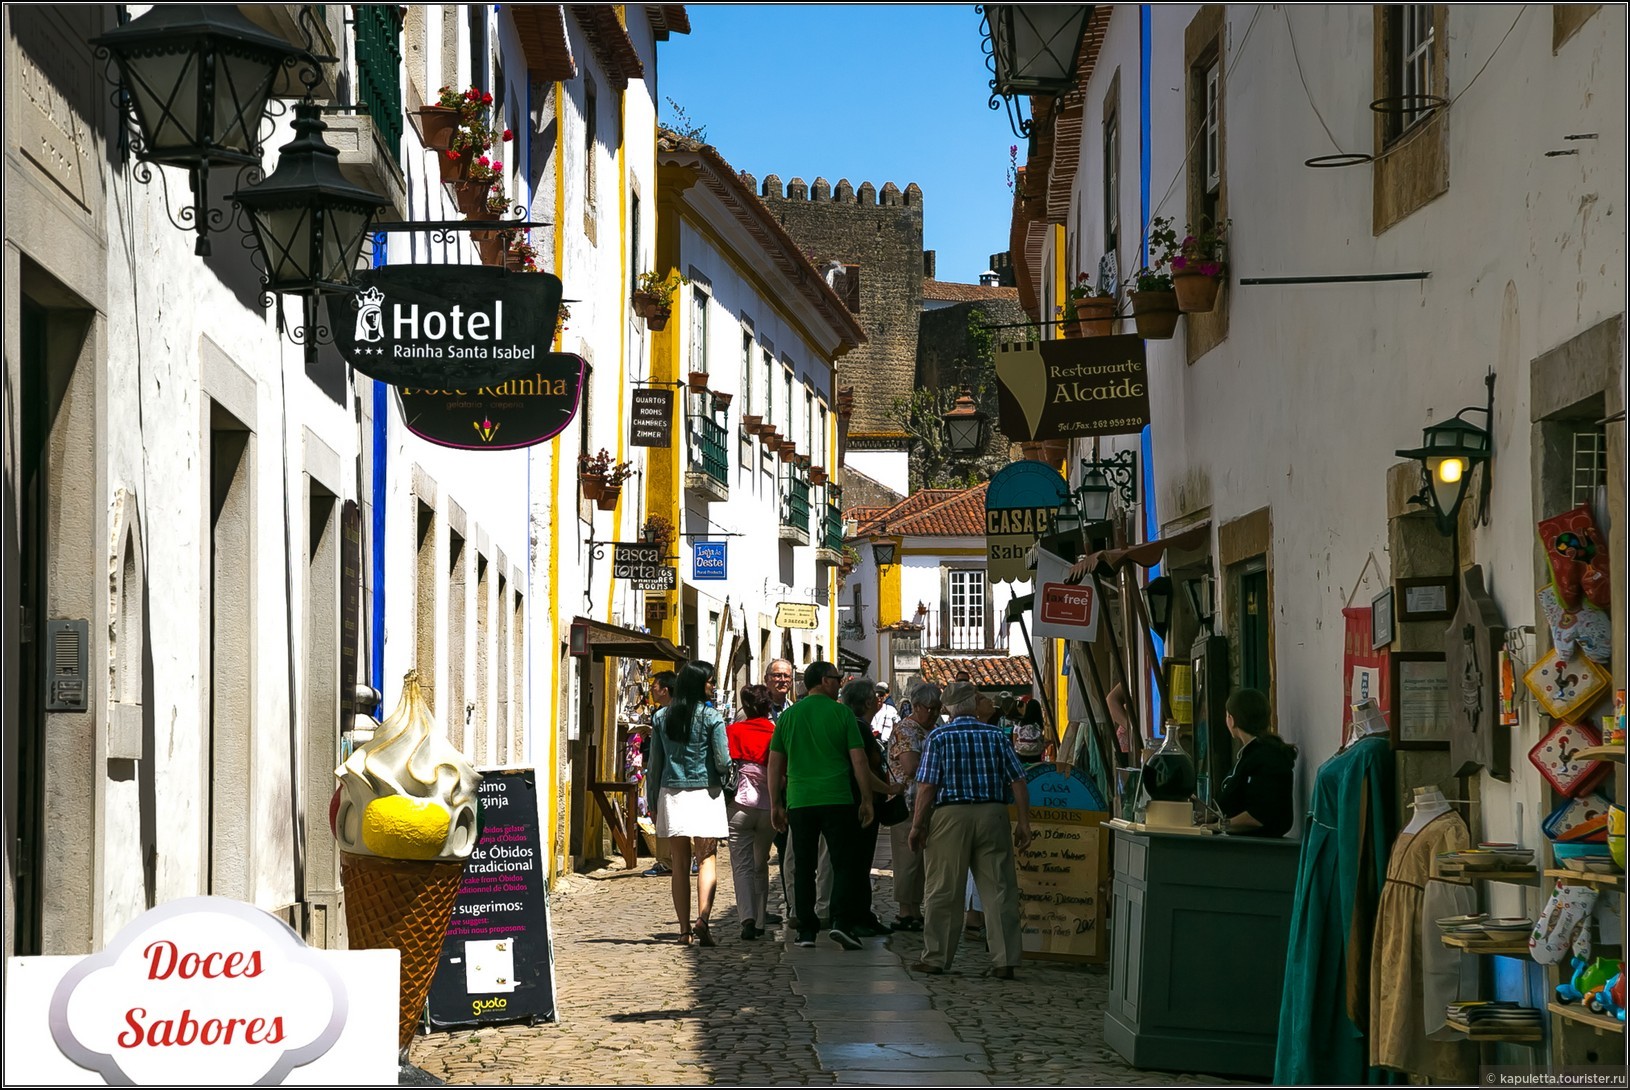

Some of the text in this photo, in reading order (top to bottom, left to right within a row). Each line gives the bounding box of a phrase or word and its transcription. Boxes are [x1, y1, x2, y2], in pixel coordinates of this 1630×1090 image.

[393, 300, 502, 340] Hotel
[394, 344, 535, 360] Rainha Santa Isabel
[1050, 360, 1141, 378] Restaurante
[1052, 378, 1143, 404] Alcaide
[446, 401, 482, 410] gelataria
[635, 397, 666, 405] QUARTOS
[640, 408, 662, 416] ROOMS
[633, 418, 667, 427] CHAMBRES
[1092, 419, 1108, 429] 262
[1109, 418, 1125, 427] 959
[1126, 417, 1142, 426] 220
[636, 430, 662, 438] ZIMMER
[614, 546, 659, 562] tasca
[696, 557, 723, 567] Oeste
[613, 562, 656, 579] torta
[1041, 782, 1071, 793] CASA
[480, 794, 509, 809] ginja
[1043, 797, 1068, 808] DOS
[1028, 810, 1082, 821] SABORES
[504, 825, 525, 834] gelato
[471, 844, 534, 860] de Óbidos
[469, 858, 533, 873] tradicional
[464, 876, 480, 884] cake
[498, 874, 523, 882] Óbidos
[493, 884, 502, 892] de
[502, 883, 527, 892] Óbidos
[459, 900, 523, 917] sugerimos:
[462, 917, 490, 927] suggest:
[489, 925, 526, 934] proposons:
[143, 940, 265, 980] Doces
[472, 997, 507, 1016] gusto
[117, 1008, 287, 1048] Sabores
